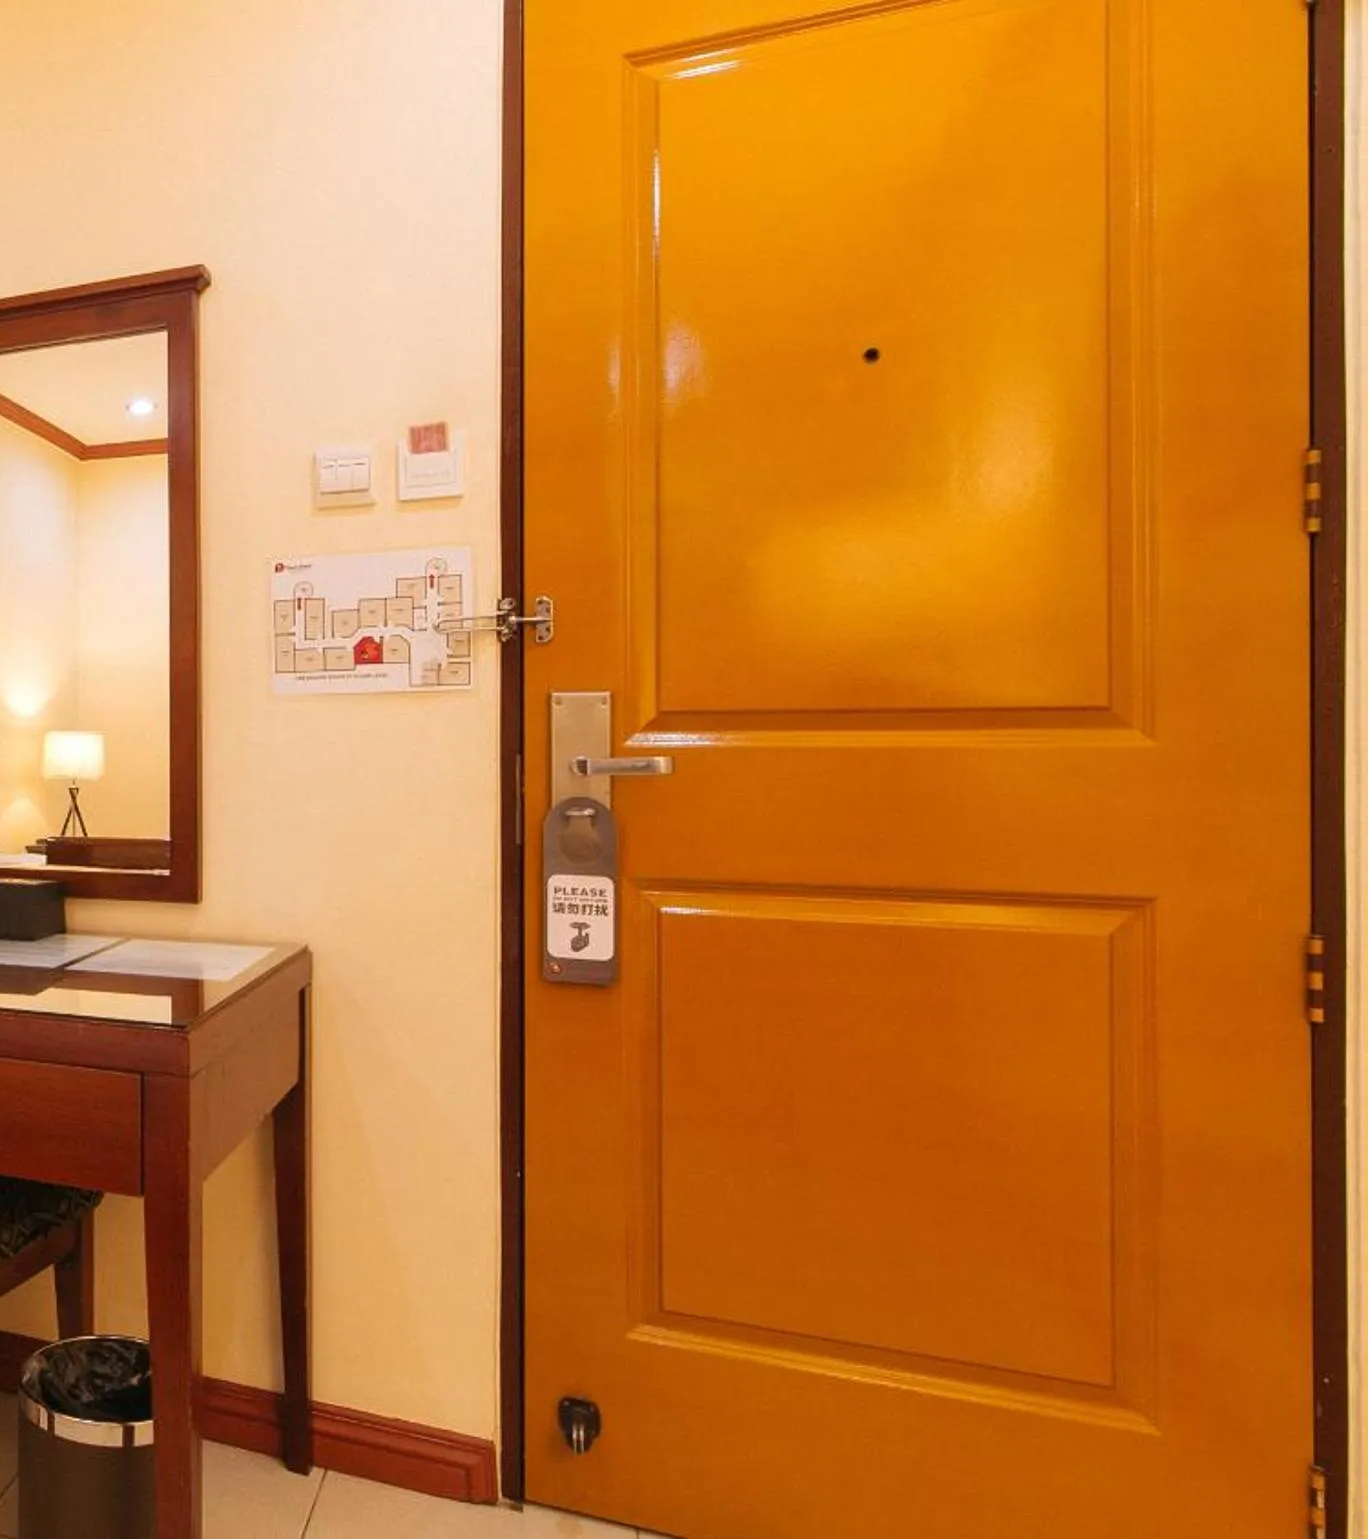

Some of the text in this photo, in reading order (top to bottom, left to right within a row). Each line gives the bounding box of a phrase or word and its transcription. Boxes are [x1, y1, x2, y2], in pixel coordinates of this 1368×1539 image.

[554, 886, 608, 897] PLEASE
[552, 902, 608, 916] 请勿打扰
